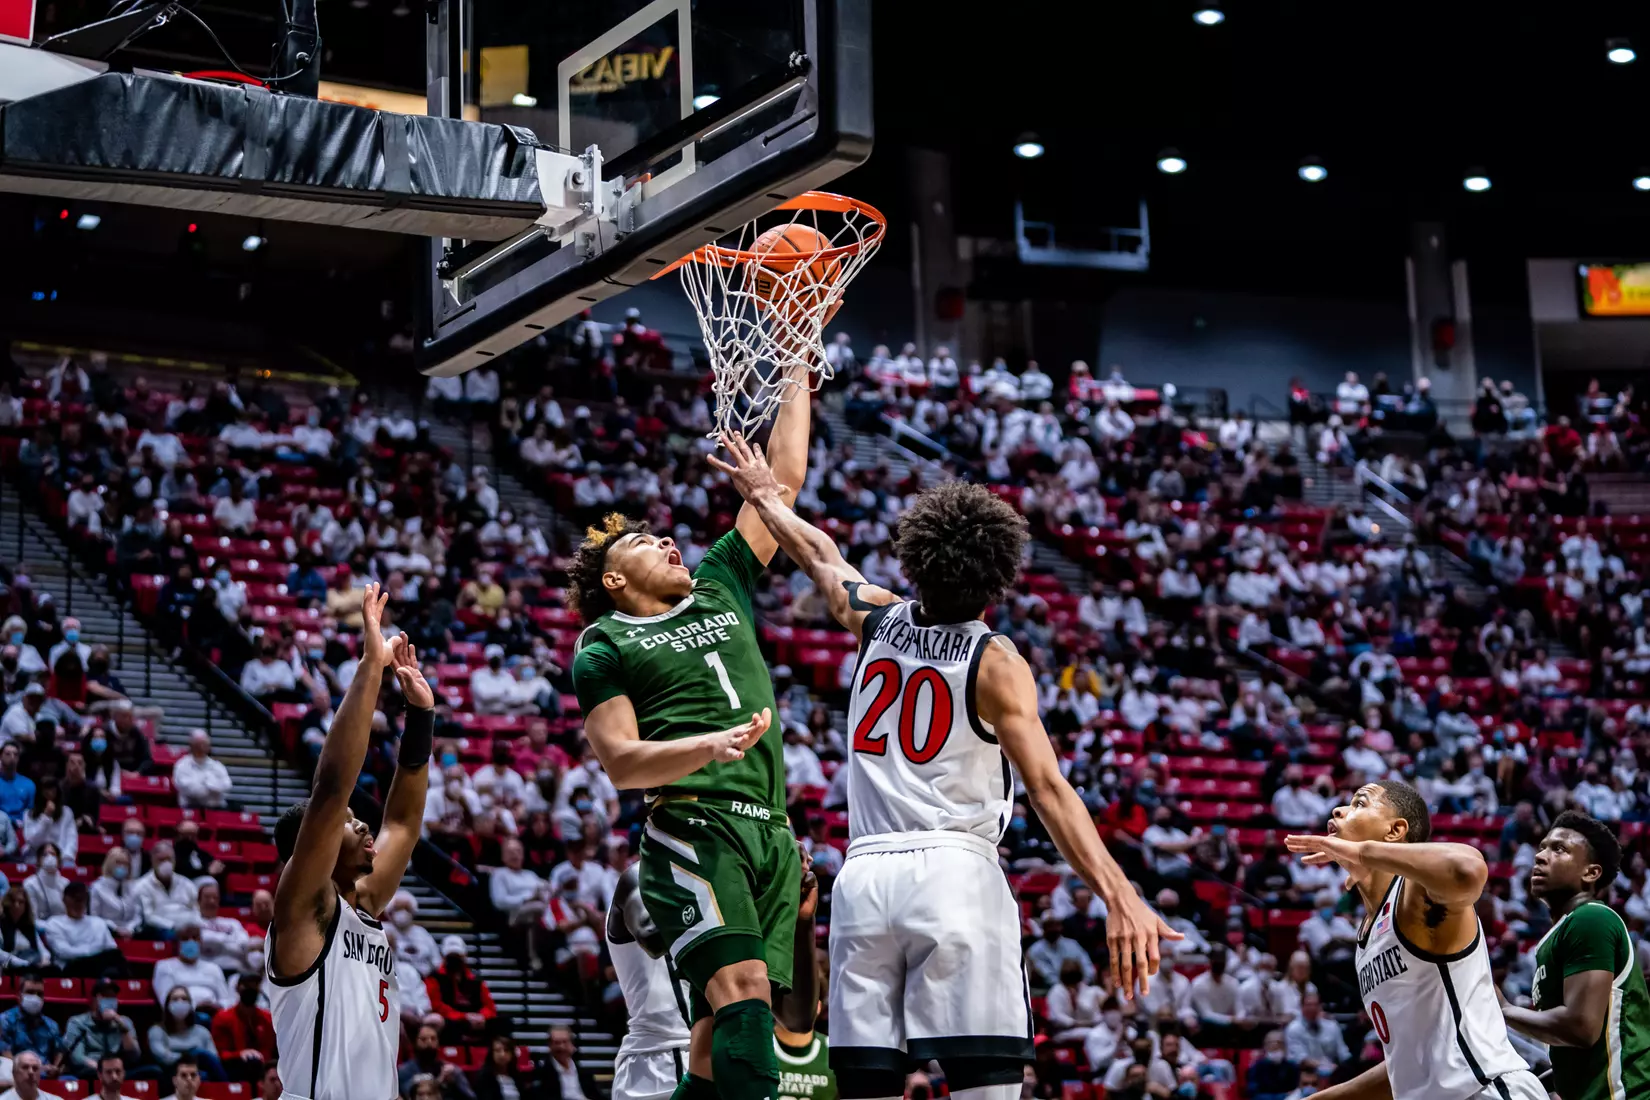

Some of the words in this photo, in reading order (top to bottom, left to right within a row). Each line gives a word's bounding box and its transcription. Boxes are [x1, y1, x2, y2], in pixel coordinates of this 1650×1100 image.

[640, 611, 740, 650] COLORADO
[670, 627, 731, 652] STATE
[703, 650, 741, 710] 1
[853, 658, 954, 765] 20
[731, 800, 771, 820] RAMS
[343, 930, 365, 962] SAN
[1373, 944, 1408, 986] STATE
[379, 979, 389, 1023] 5
[1371, 1001, 1390, 1044] 0
[777, 1081, 814, 1096] STATE
[778, 1071, 828, 1087] LORADO
